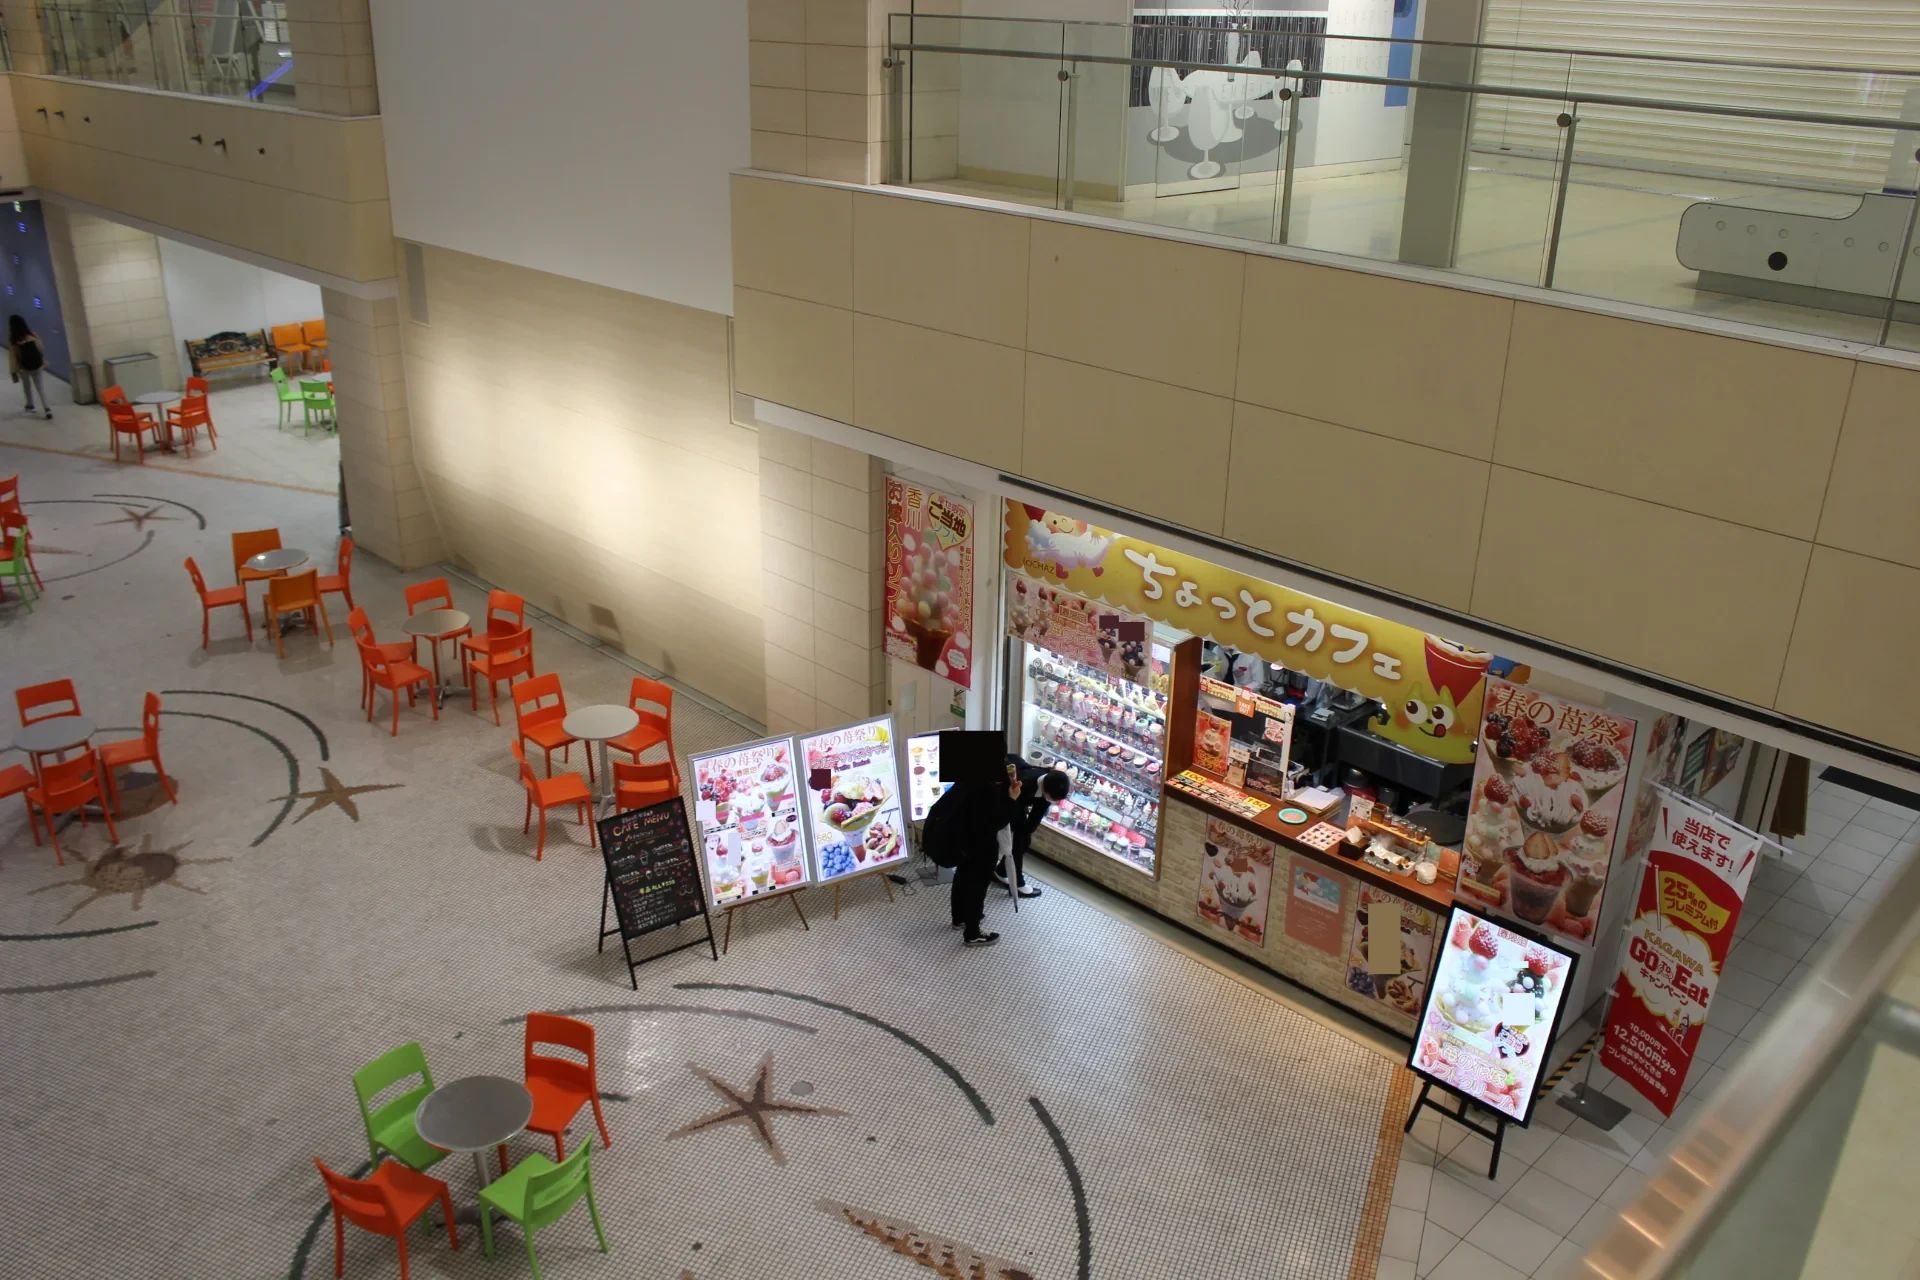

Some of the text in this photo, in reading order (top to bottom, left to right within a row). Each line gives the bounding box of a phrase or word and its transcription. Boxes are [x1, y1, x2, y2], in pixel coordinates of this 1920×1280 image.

[929, 501, 967, 537] ご当地
[1124, 549, 1401, 680] ちょっとカフェ
[644, 811, 670, 826] MENU
[1684, 817, 1731, 851] 当店で
[1671, 830, 1735, 873] 使えます!
[1664, 877, 1708, 911] 25%の
[1664, 897, 1719, 931] プレミアム付
[1644, 928, 1704, 976] KAGAWA
[1640, 967, 1689, 1006] キャンペーン
[1671, 964, 1710, 1008] Eat
